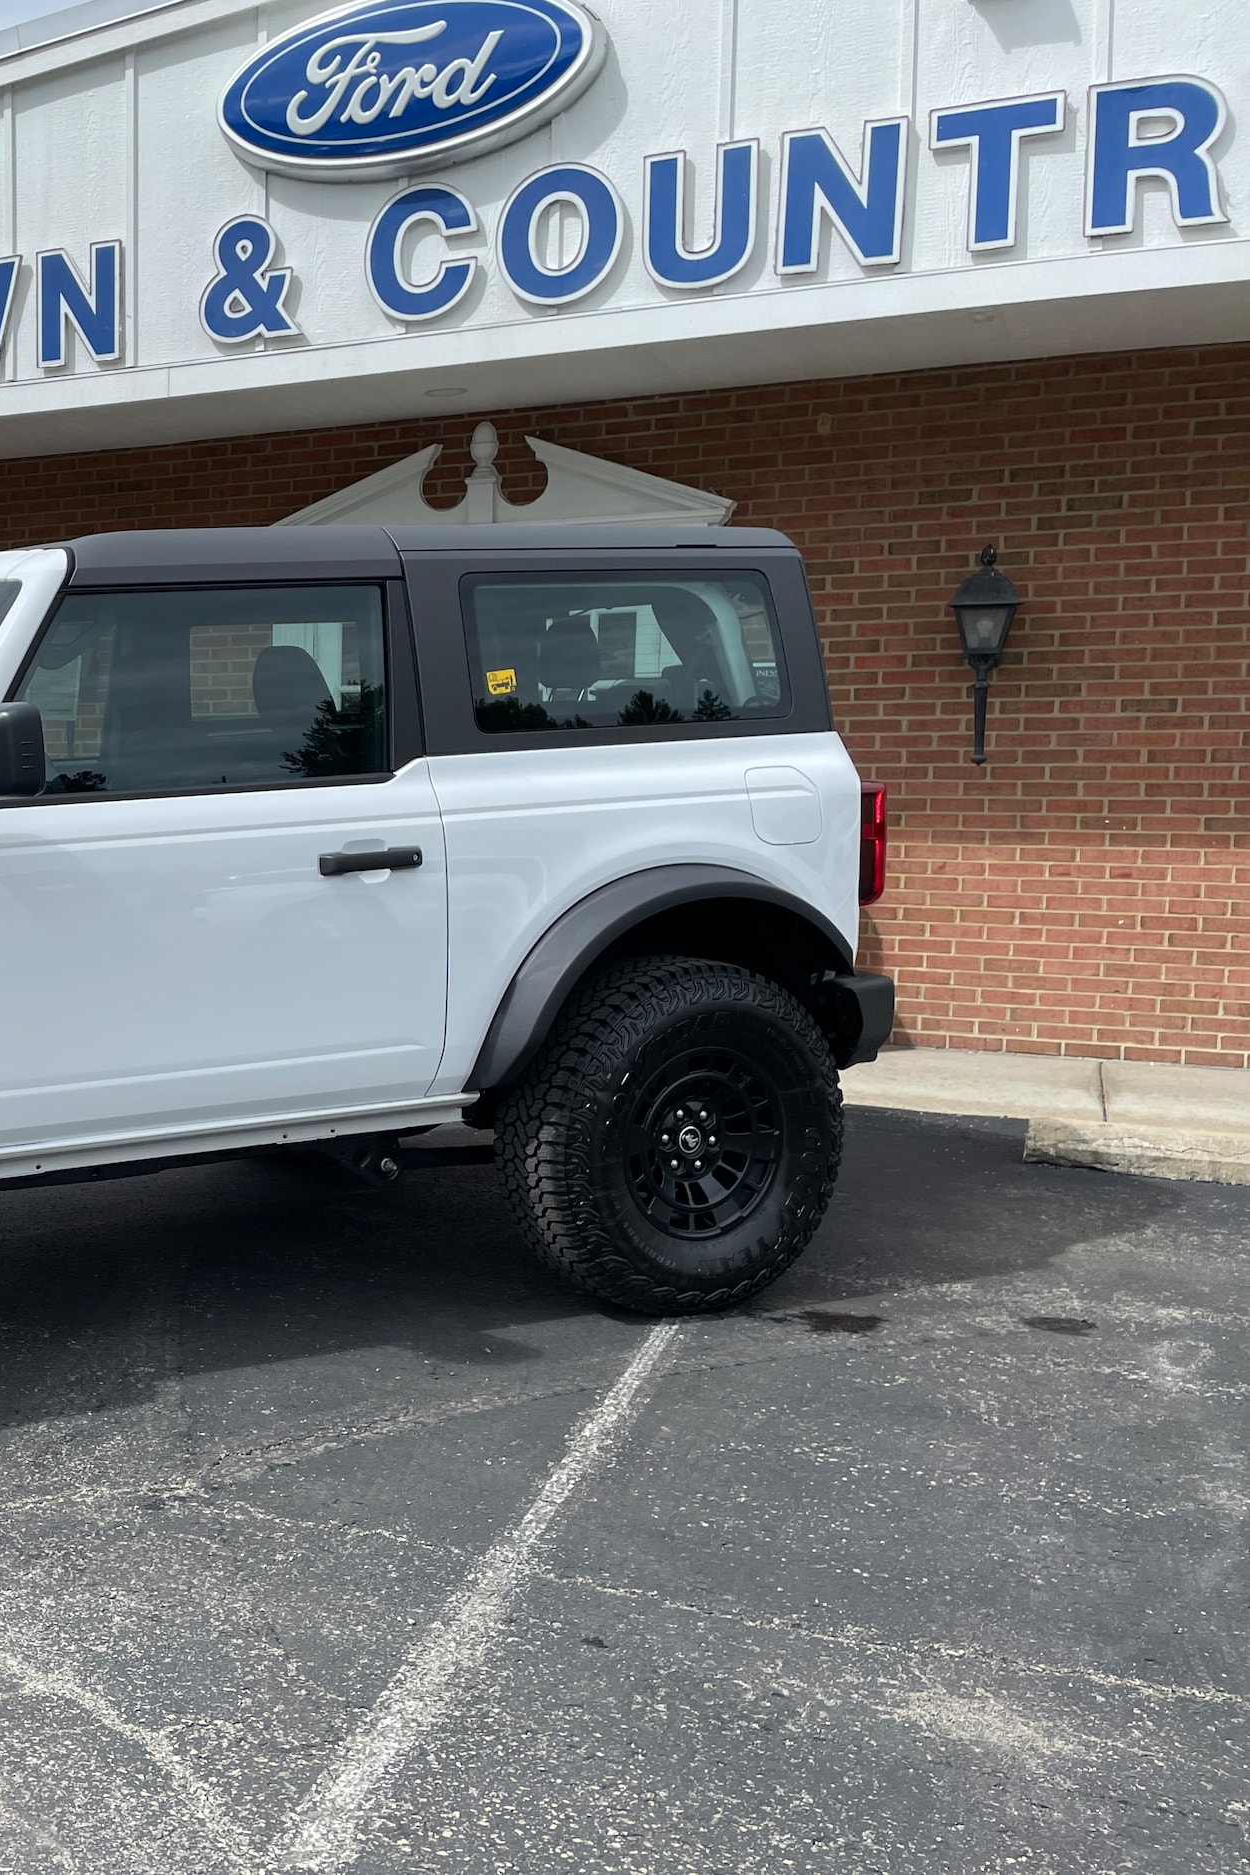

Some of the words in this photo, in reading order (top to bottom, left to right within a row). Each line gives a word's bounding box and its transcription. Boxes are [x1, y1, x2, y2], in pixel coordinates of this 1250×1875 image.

[285, 19, 505, 136] Ford
[199, 214, 302, 345] &
[365, 74, 1230, 322] COUNTR
